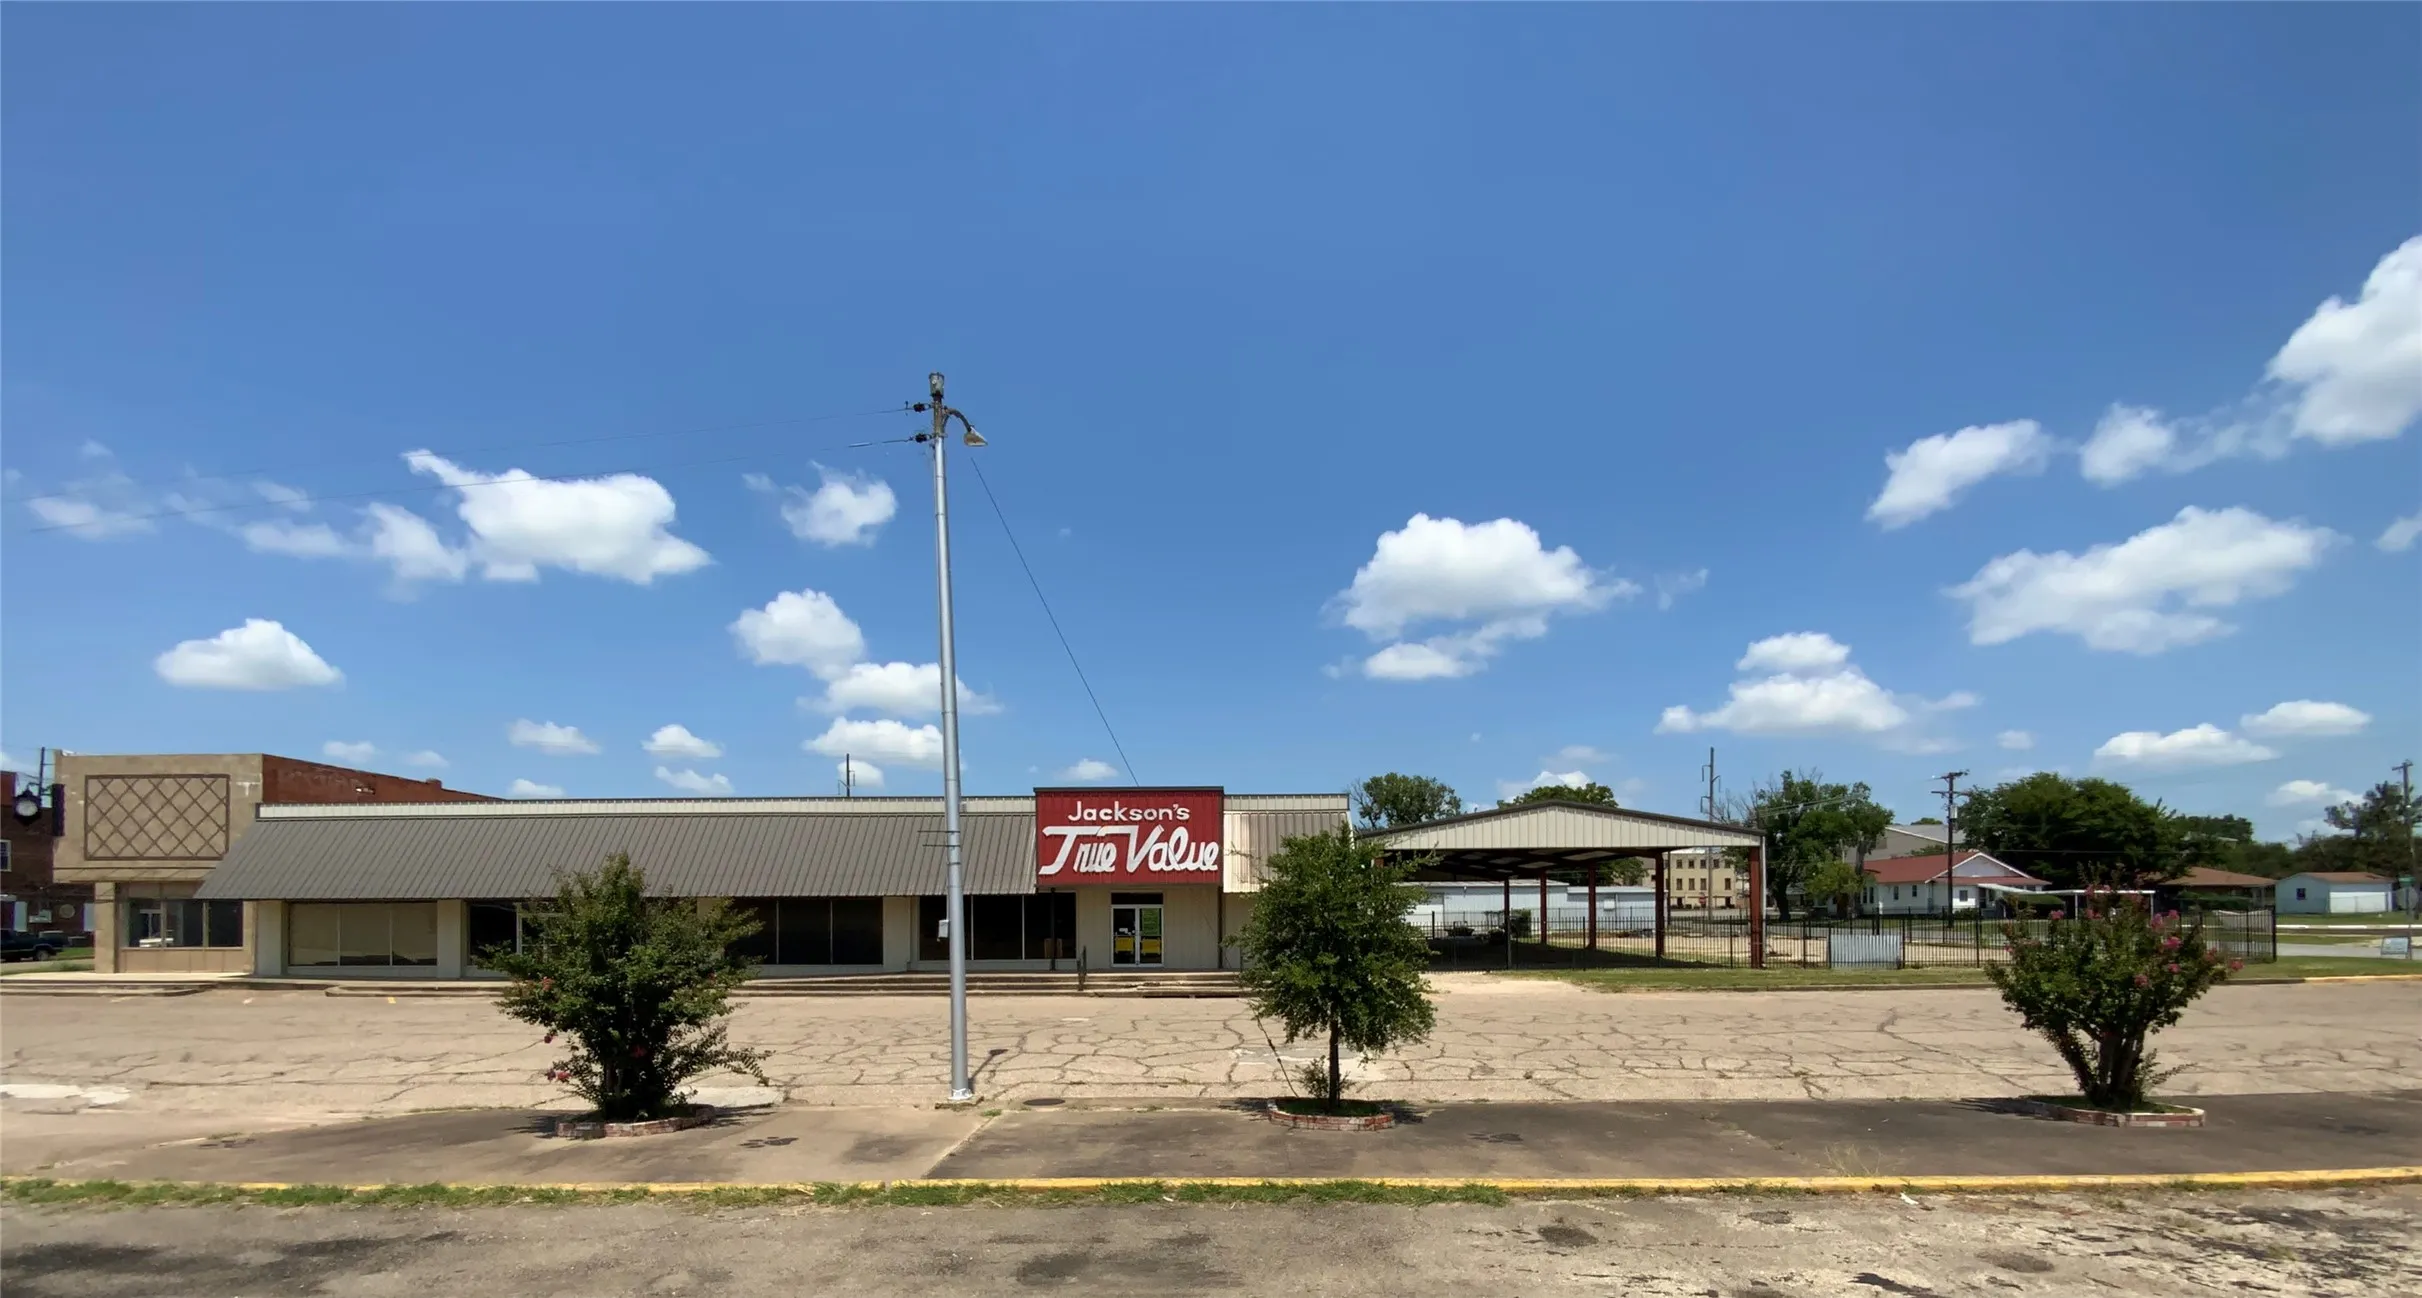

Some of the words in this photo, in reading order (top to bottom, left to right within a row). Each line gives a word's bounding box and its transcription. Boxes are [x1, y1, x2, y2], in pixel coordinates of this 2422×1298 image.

[1068, 801, 1190, 821] Jackson's
[1038, 826, 1117, 875] True
[1097, 824, 1219, 873] Value
